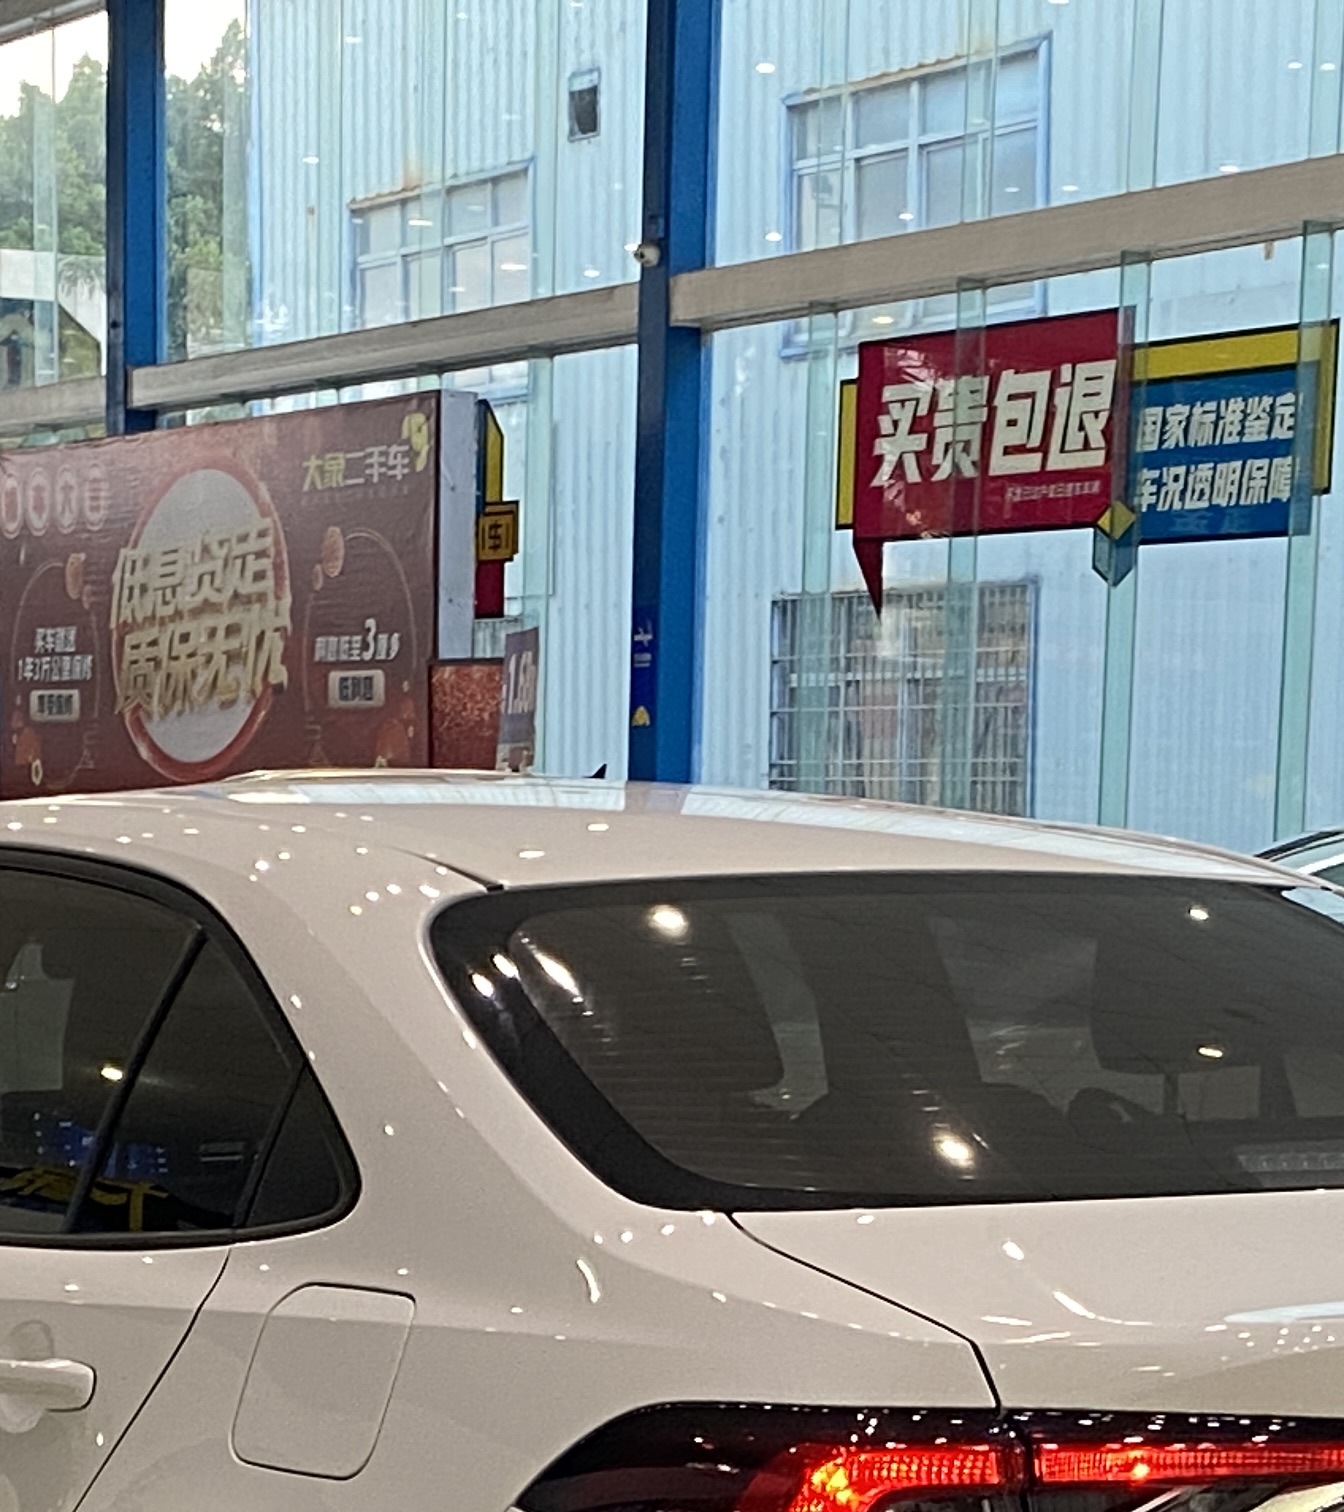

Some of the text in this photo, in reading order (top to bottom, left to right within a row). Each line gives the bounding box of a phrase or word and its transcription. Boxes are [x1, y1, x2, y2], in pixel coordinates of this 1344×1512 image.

[869, 359, 1118, 487] 买贵包退
[1136, 392, 1299, 452] 国家标准鉴定
[302, 444, 410, 492] 大象二手车
[1136, 455, 1296, 512] 车况透明保障
